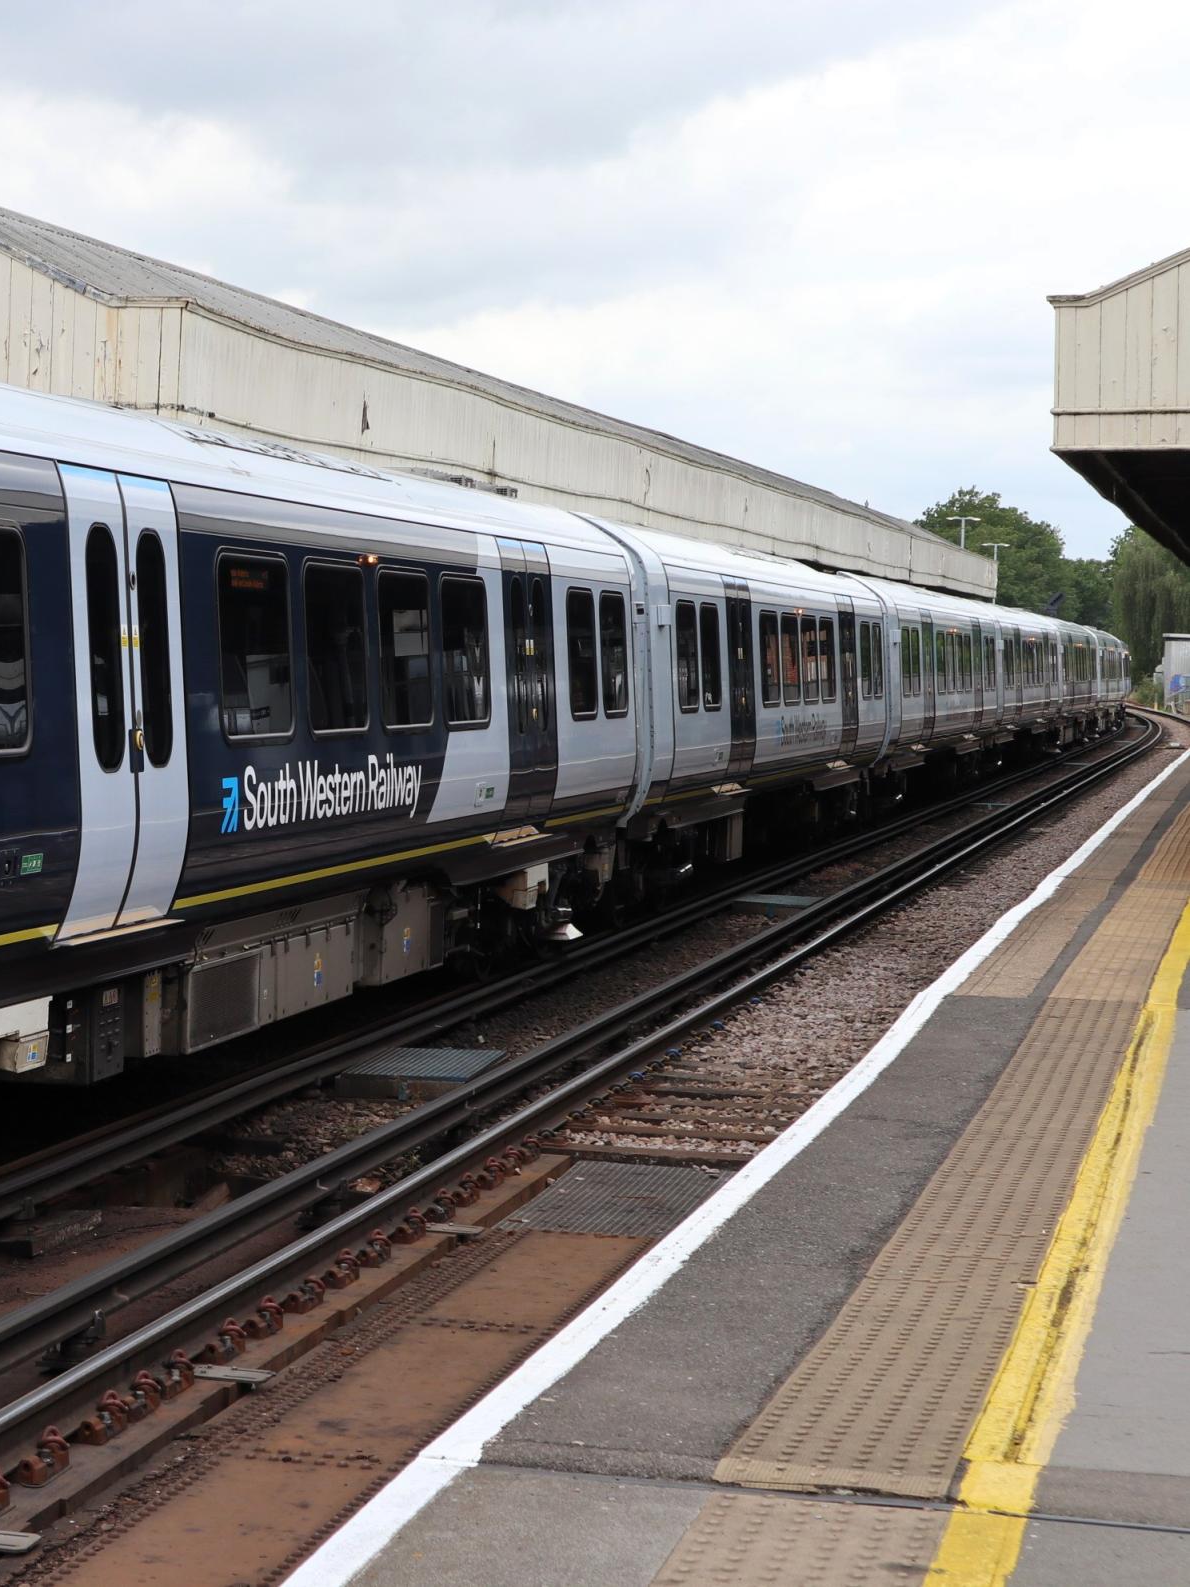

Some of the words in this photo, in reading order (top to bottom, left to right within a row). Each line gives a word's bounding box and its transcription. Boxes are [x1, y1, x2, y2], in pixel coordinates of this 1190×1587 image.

[244, 762, 298, 831] South
[298, 759, 367, 822] Western
[367, 752, 422, 819] Railway
